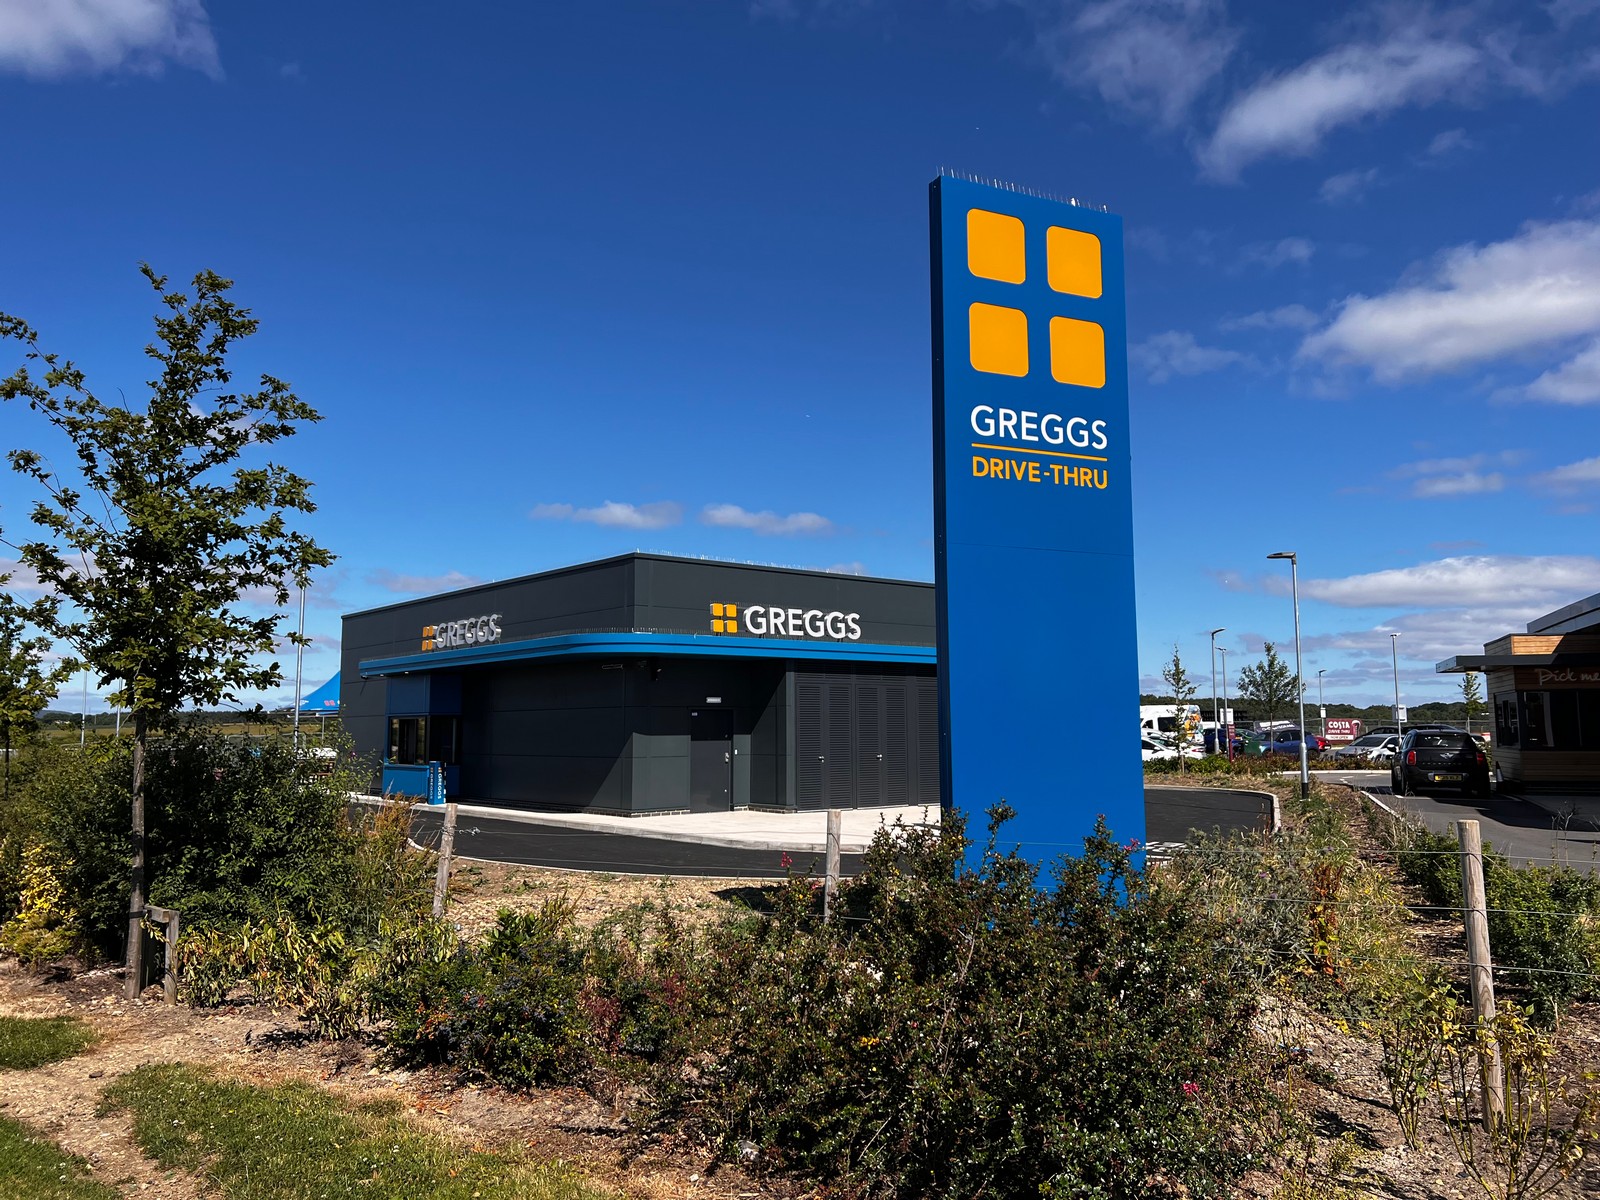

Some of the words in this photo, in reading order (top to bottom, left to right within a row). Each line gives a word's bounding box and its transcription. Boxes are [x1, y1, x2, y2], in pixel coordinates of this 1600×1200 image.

[971, 405, 1108, 450] GREGGS
[973, 456, 1108, 489] DRIVE-THRU
[436, 614, 501, 648] GREGGS
[744, 605, 861, 640] GREGGS
[1534, 668, 1577, 686] Pick
[1328, 721, 1350, 730] COSTA
